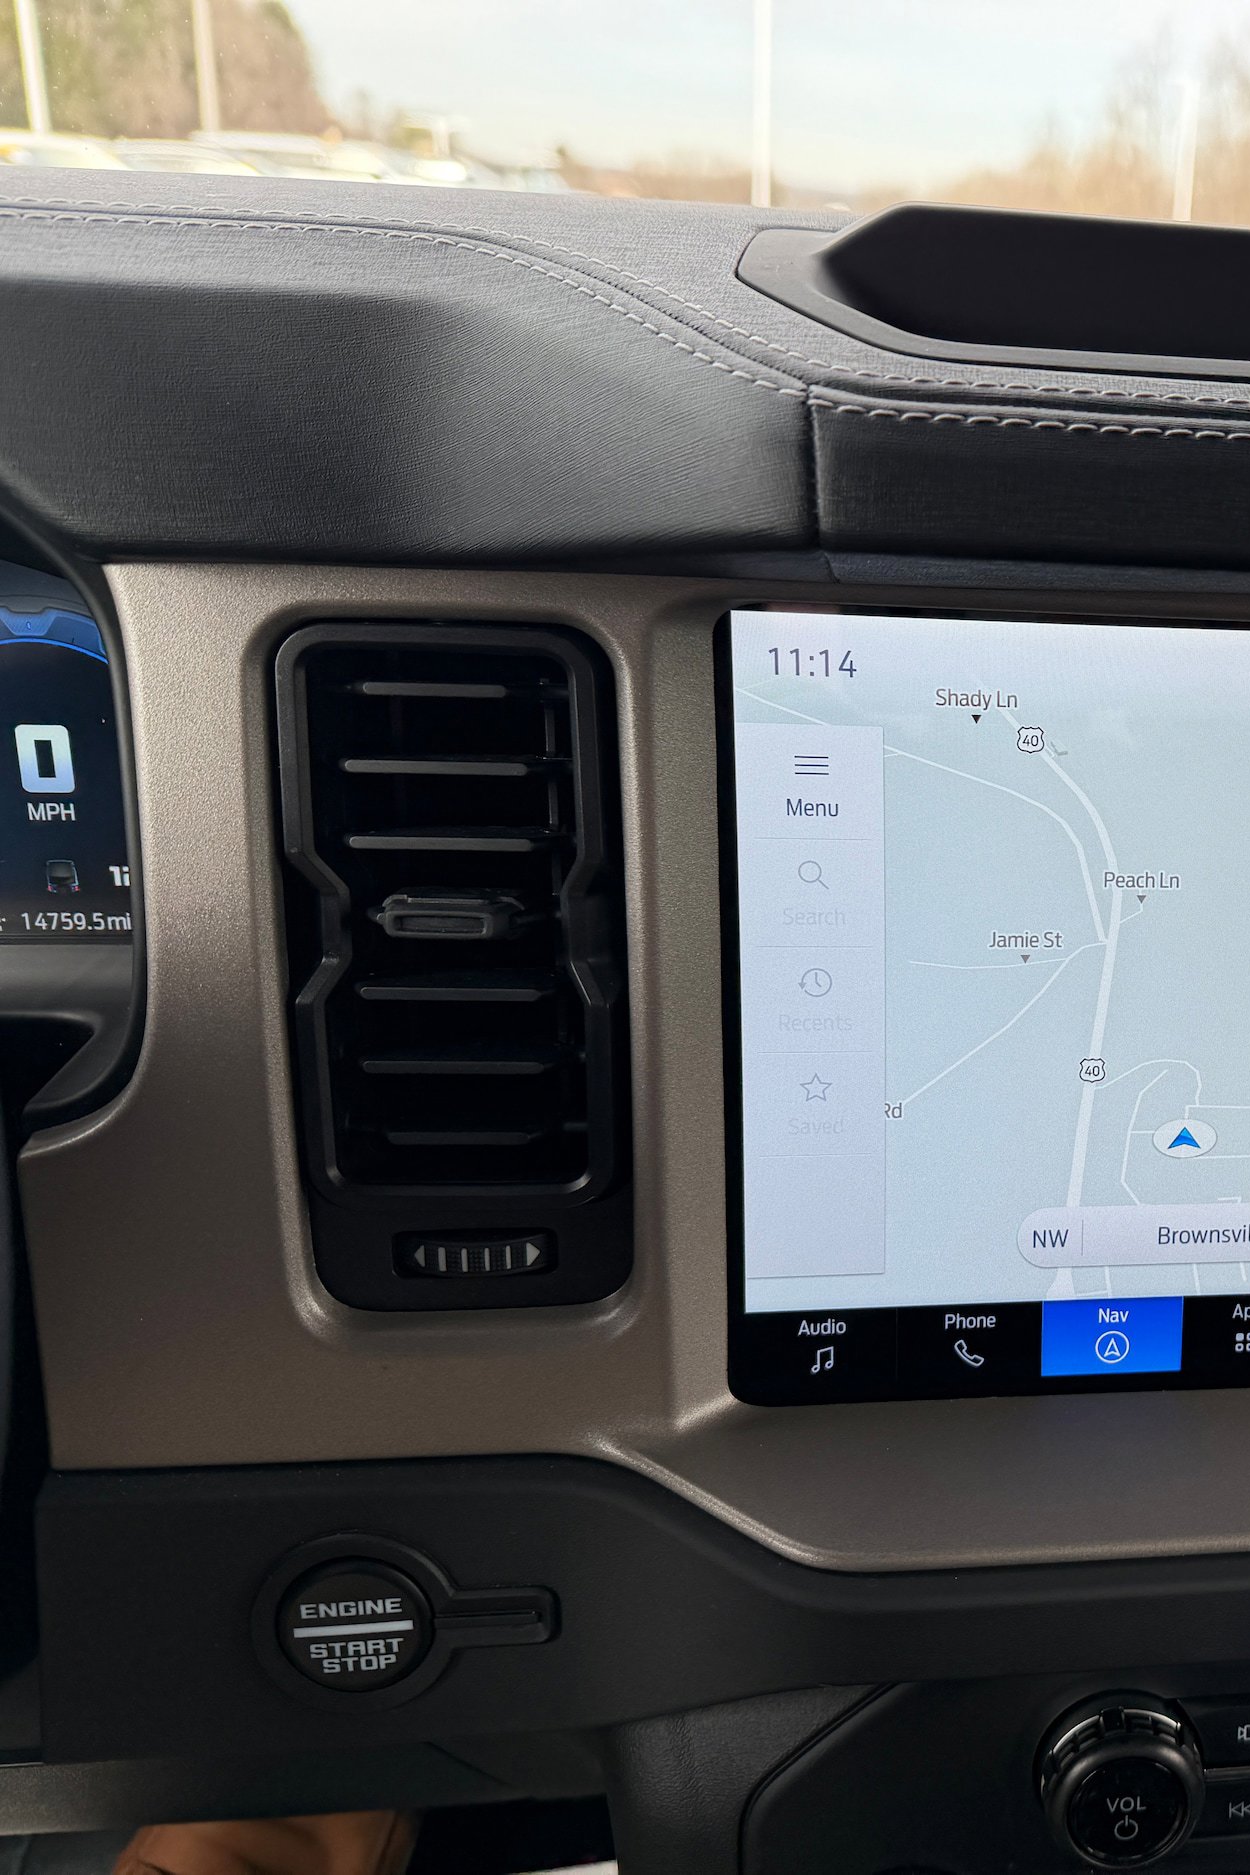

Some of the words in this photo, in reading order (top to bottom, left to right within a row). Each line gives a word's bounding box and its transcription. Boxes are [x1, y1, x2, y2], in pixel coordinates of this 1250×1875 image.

[768, 647, 858, 679] 11:14
[935, 687, 993, 710] Shady
[996, 690, 1018, 709] Ln
[1022, 734, 1039, 748] 40
[14, 724, 76, 794] 0
[27, 803, 76, 822] MPH
[786, 798, 840, 818] Menu
[1103, 871, 1157, 890] Peach
[1159, 873, 1180, 890] Ln
[782, 907, 846, 926] Search
[988, 931, 1039, 949] Jamie
[1043, 931, 1063, 949] St
[778, 1013, 853, 1033] Recents
[1084, 1065, 1102, 1078] 40
[788, 1117, 844, 1136] Saved
[1032, 1229, 1069, 1248] NW
[945, 1313, 996, 1331] Phone
[1098, 1308, 1129, 1324] Nav
[798, 1318, 847, 1336] Audio
[299, 1597, 403, 1620] ENGINE
[309, 1637, 404, 1659] START
[322, 1655, 397, 1674] STOP
[1106, 1795, 1147, 1814] VOL
